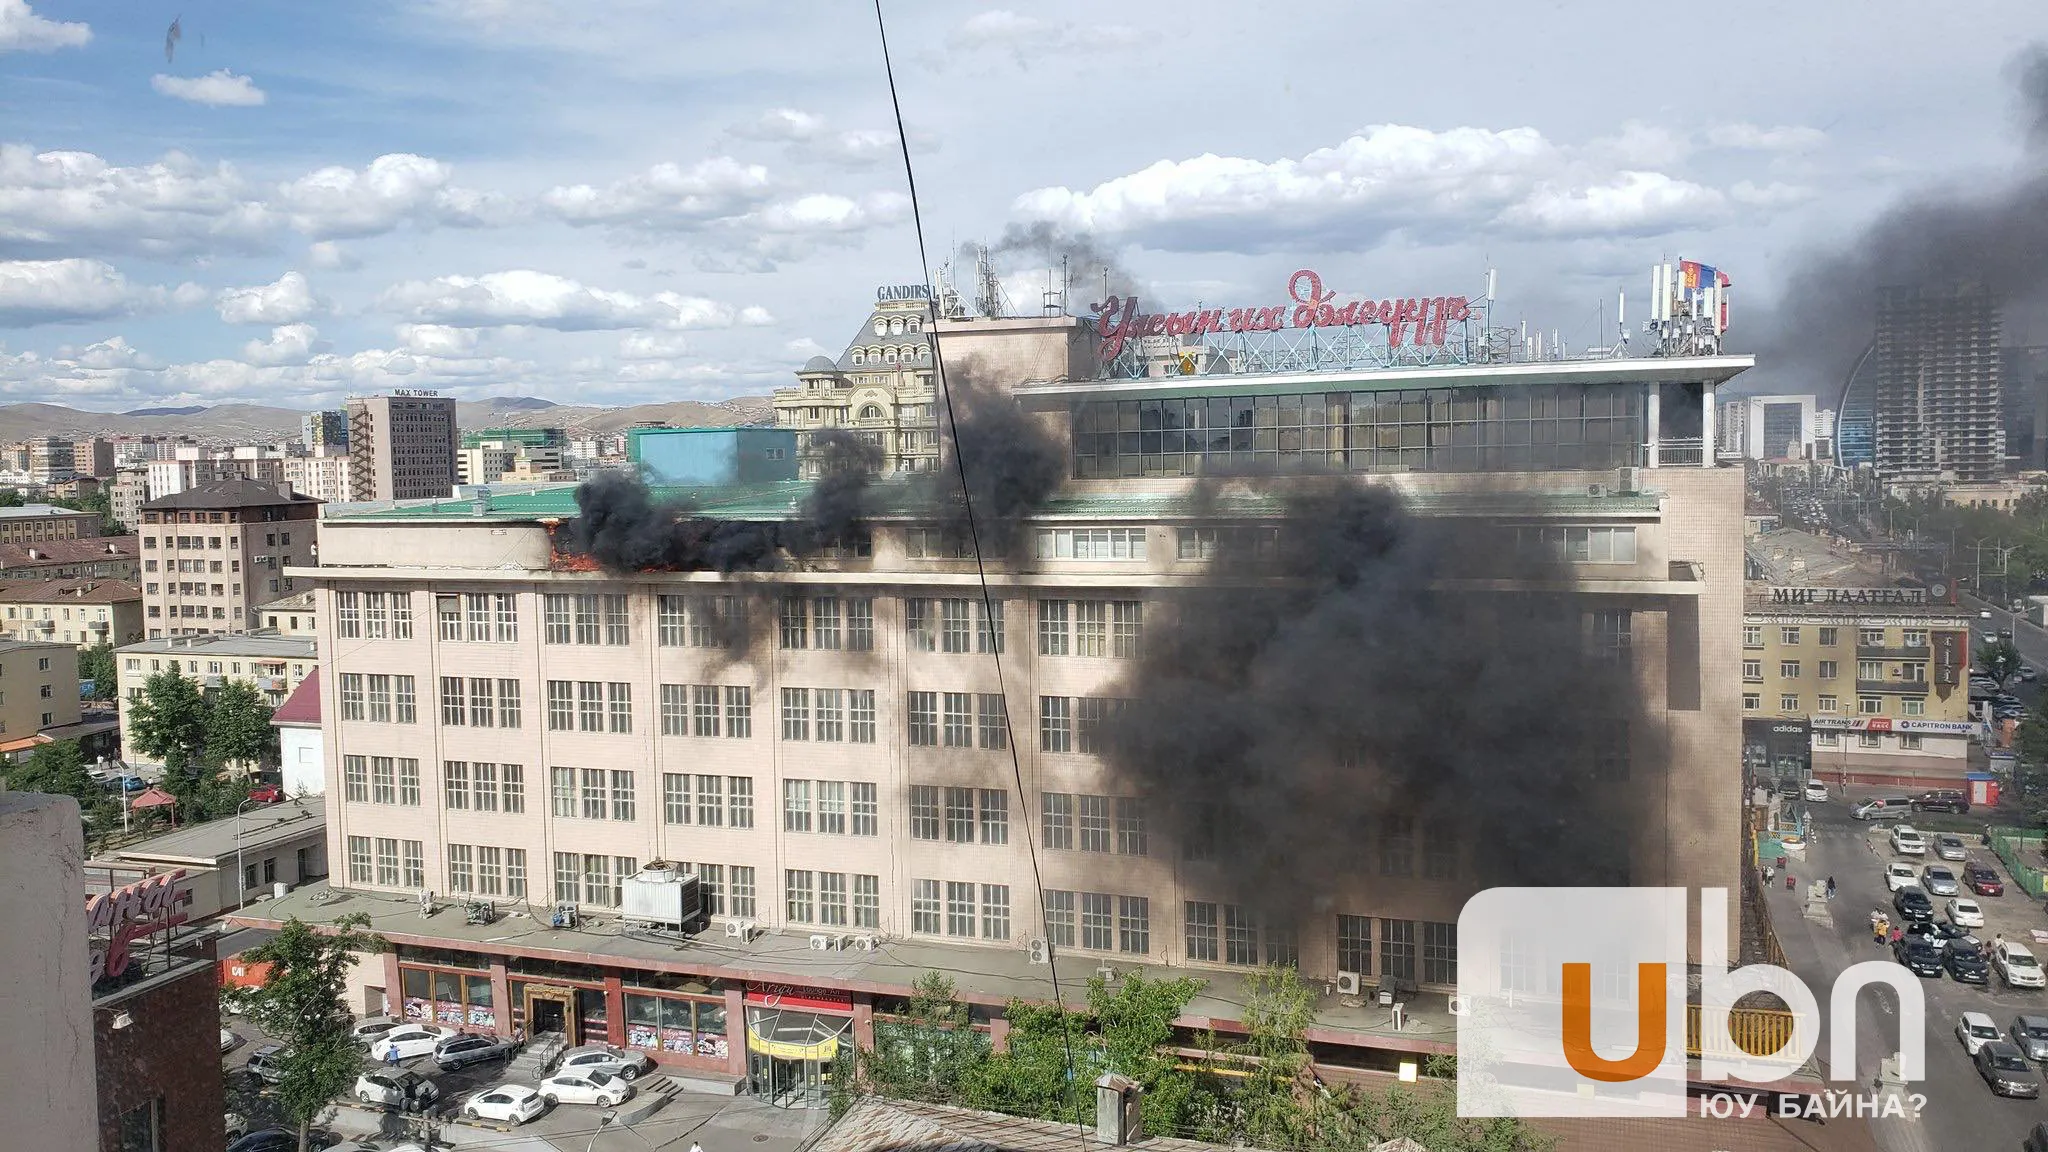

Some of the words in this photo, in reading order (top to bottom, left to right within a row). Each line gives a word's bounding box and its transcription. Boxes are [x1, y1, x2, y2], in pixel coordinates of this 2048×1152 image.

[877, 284, 928, 300] GANDIRS
[394, 388, 411, 397] MAX
[413, 389, 438, 397] TOWER
[1772, 588, 1818, 604] МИГ
[1823, 588, 1925, 605] ДААТГАЛ
[1813, 718, 1827, 726] AIR
[1911, 721, 1950, 730] CAPITRON
[1951, 723, 1973, 731] BANK
[1773, 725, 1803, 733] adidas
